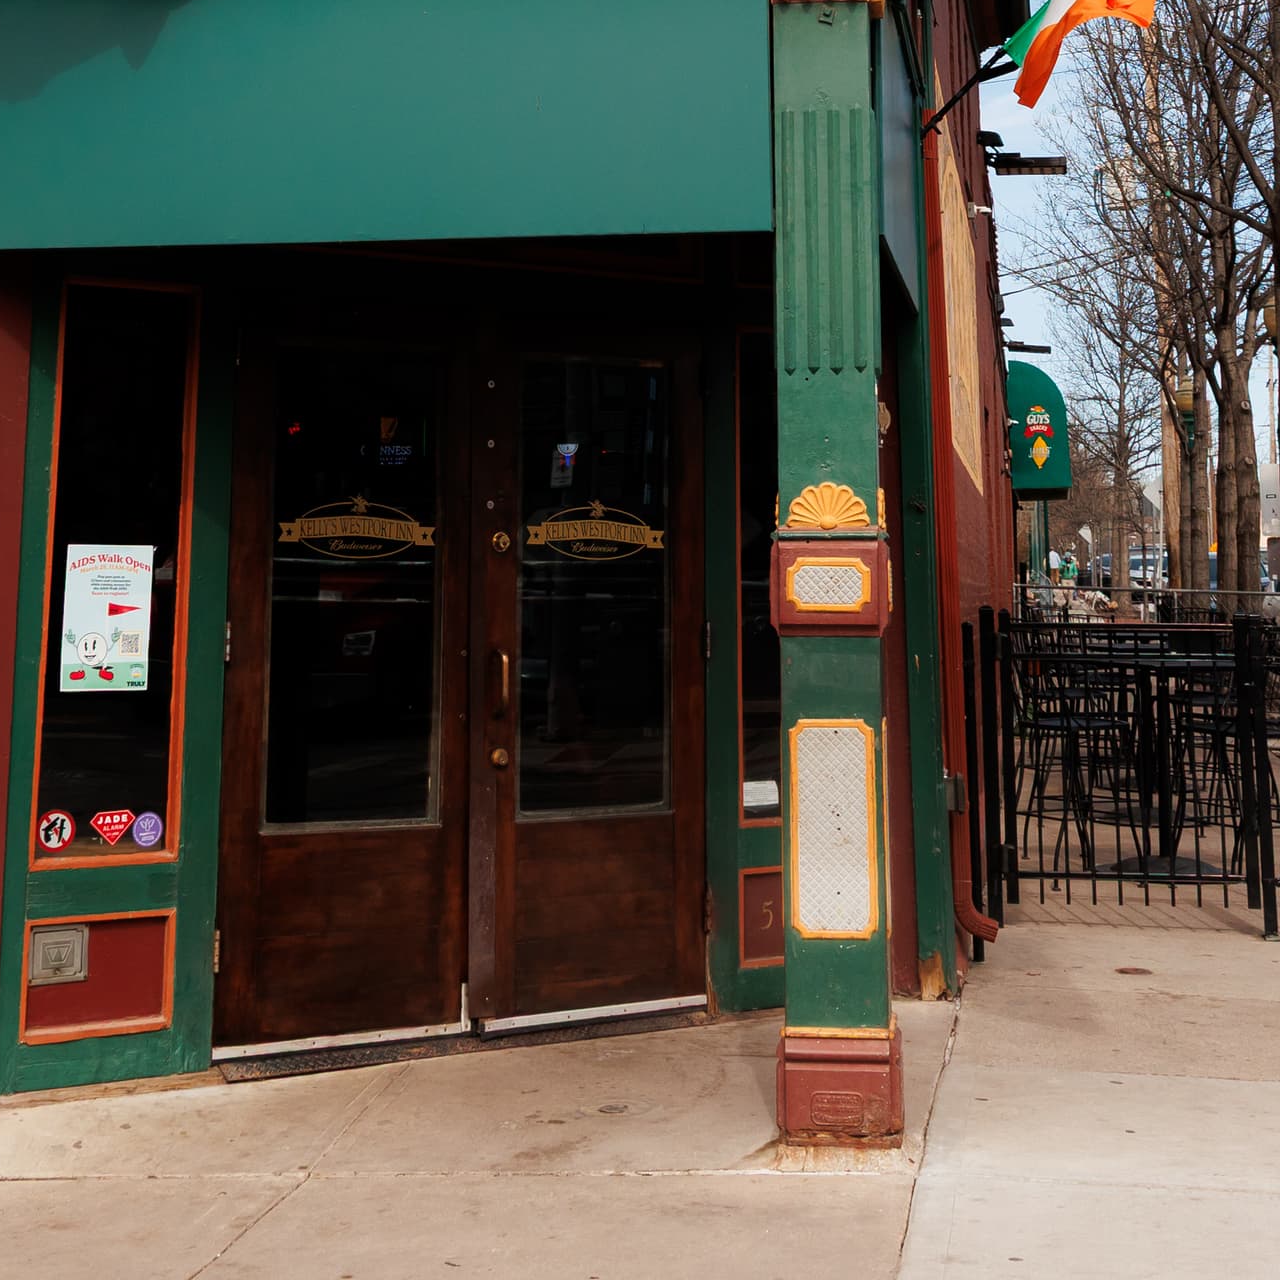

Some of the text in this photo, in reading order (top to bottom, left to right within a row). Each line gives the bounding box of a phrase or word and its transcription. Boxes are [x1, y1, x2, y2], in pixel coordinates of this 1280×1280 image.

[339, 517, 393, 539] WESTPORT
[395, 522, 415, 542] INN
[579, 521, 628, 543] WESTPORT
[629, 525, 647, 544] INN
[327, 538, 384, 552] Budweiser
[570, 541, 619, 554] Budweiser
[69, 555, 96, 571] AIDS
[97, 553, 123, 564] Walk
[125, 556, 151, 572] Open
[96, 813, 129, 825] JADE
[102, 823, 125, 832] ALARM
